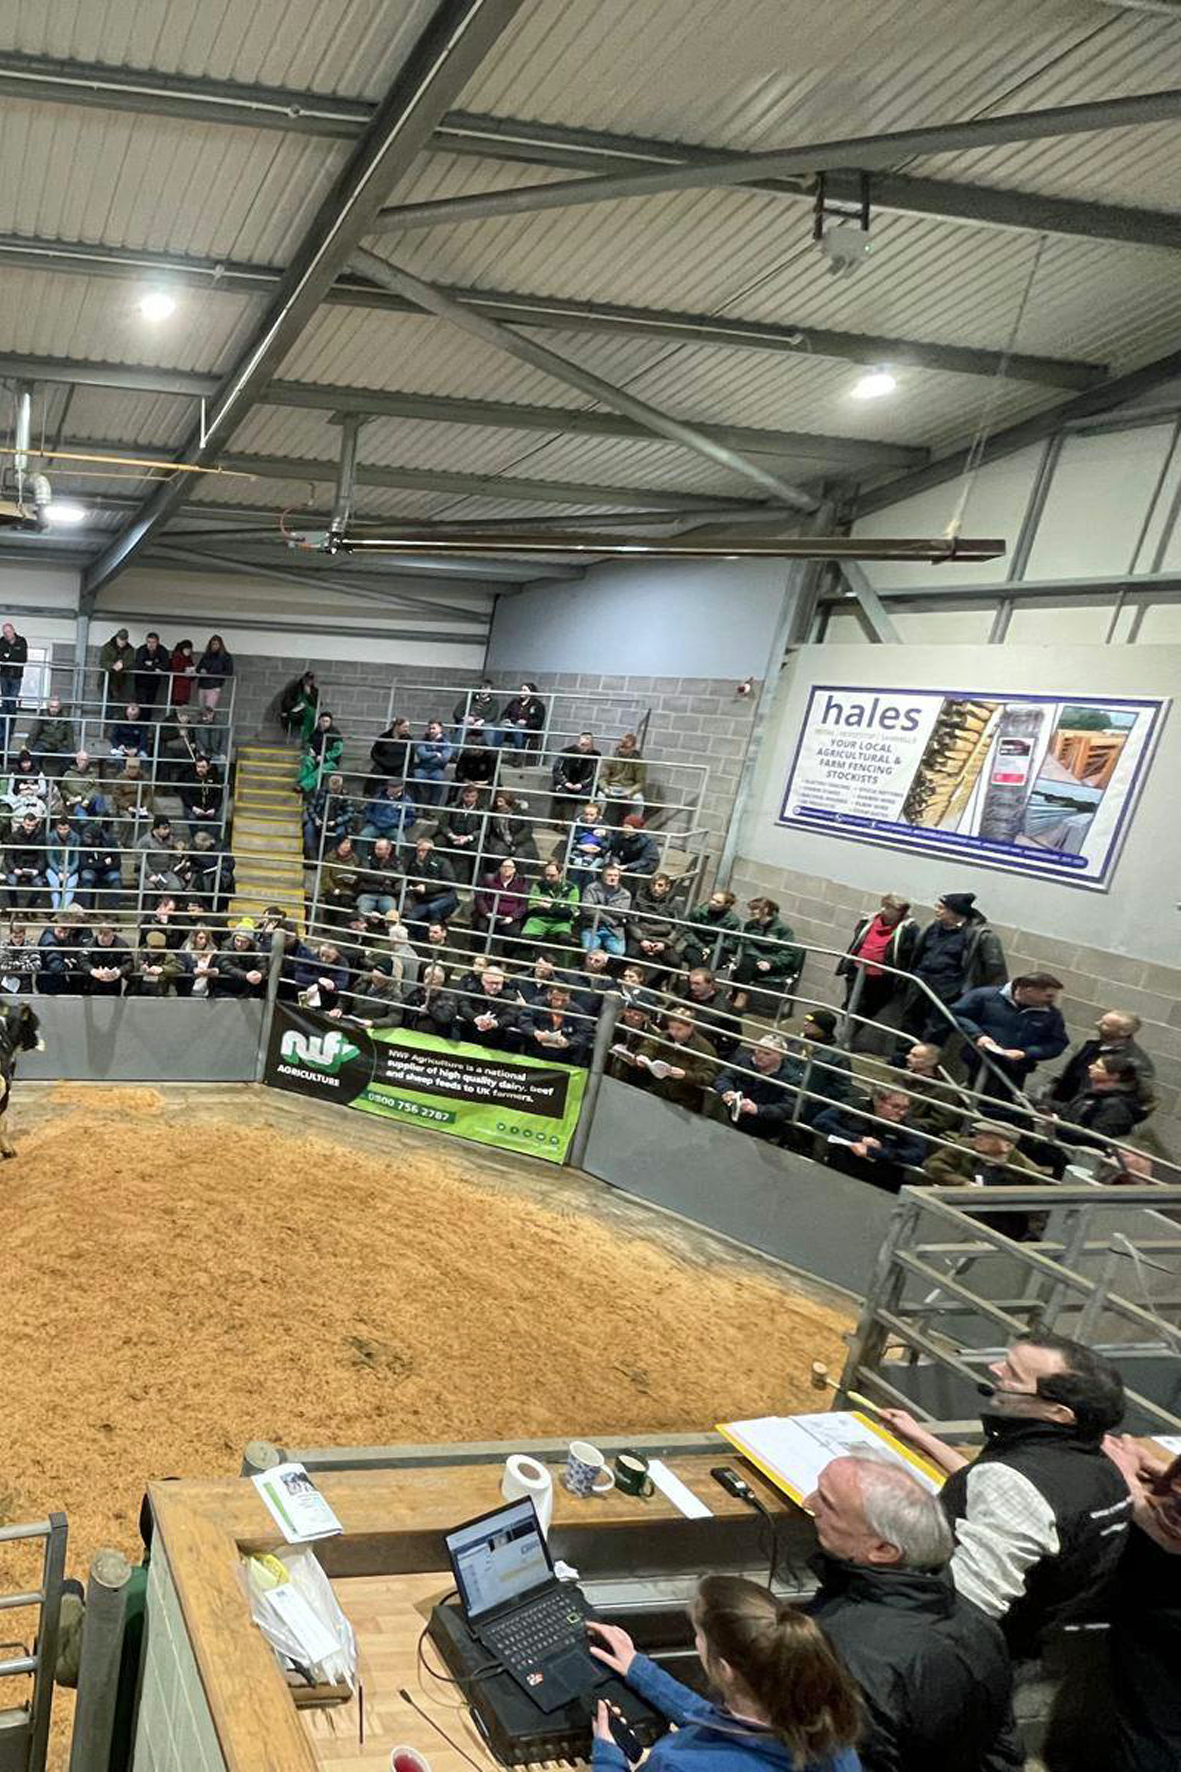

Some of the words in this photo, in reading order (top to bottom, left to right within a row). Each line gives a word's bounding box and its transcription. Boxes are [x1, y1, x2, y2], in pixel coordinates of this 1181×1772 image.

[821, 695, 922, 731] hales
[817, 748, 891, 764] AGRICULTURAL
[894, 757, 902, 765] &
[830, 740, 857, 749] YOUR
[859, 742, 892, 753] LOCAL
[819, 759, 846, 769] FARM
[847, 762, 893, 775] FENCING
[826, 770, 879, 784] STOCKISTS
[388, 1049, 410, 1059] NWF
[411, 1055, 464, 1070] Agriculture
[466, 1064, 474, 1072] is
[484, 1068, 527, 1081] national
[277, 1065, 341, 1087] AGRICULTURE
[386, 1070, 404, 1079] and
[405, 1073, 433, 1085] sheep
[435, 1078, 462, 1090] feeds
[463, 1084, 474, 1093] to
[476, 1086, 491, 1095] UK
[387, 1060, 425, 1072] supplier
[439, 1068, 461, 1080] high
[462, 1074, 498, 1088] quality
[530, 1085, 554, 1096] beef
[398, 1101, 419, 1113] 756
[421, 1108, 450, 1121] 2787
